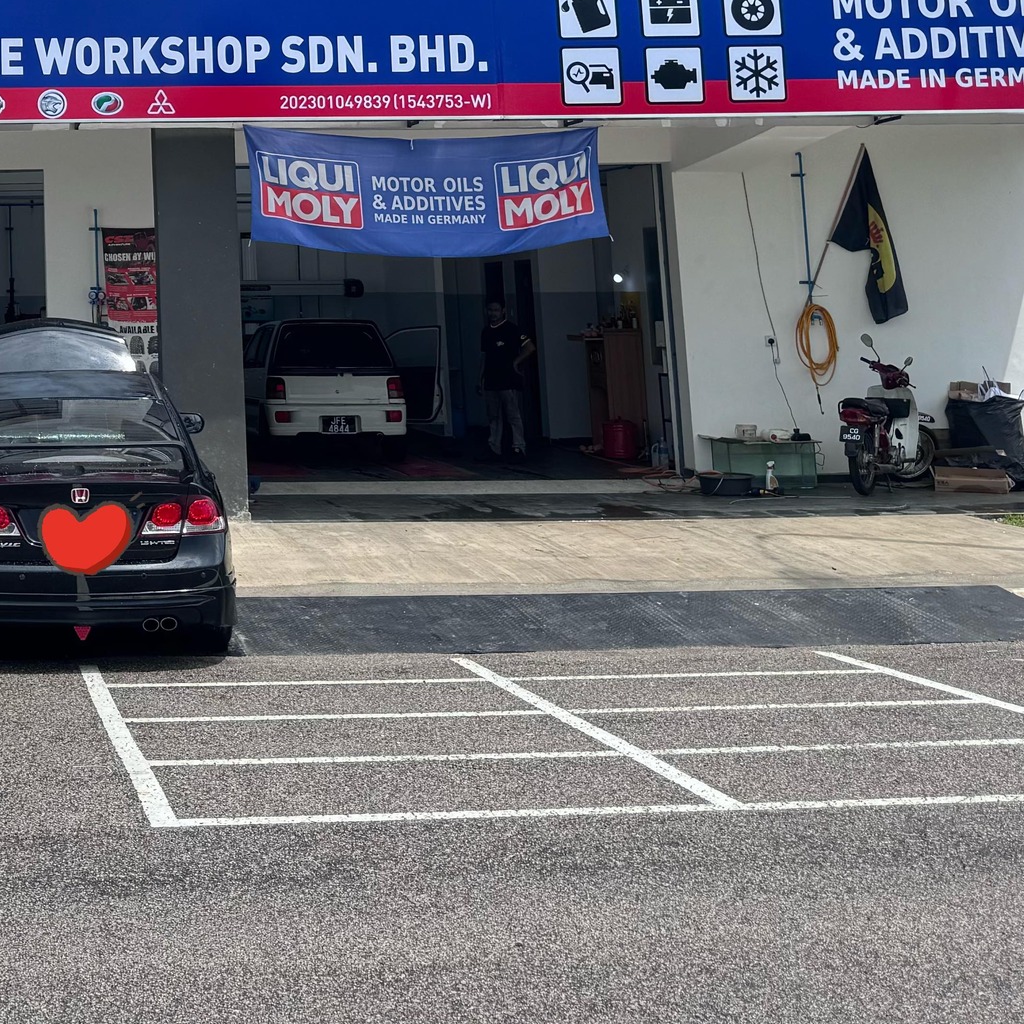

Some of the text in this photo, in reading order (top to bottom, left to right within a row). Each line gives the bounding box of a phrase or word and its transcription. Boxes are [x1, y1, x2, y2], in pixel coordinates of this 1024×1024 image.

[833, 25, 1024, 62] & ADDITIV
[34, 35, 271, 76] WORKSHOP
[280, 34, 377, 74] SDN.
[392, 34, 488, 73] BHD.
[837, 67, 1024, 90] MADE IN GERM
[262, 156, 355, 193] LIQUI
[500, 150, 588, 194] LIQUI
[371, 175, 484, 193] MOTOR OILS
[267, 188, 360, 225] MOLY
[372, 194, 486, 211] & ADDITIVES
[503, 182, 589, 226] MOLY
[374, 213, 486, 225] MADE IN GERMANY
[104, 252, 131, 262] CHOSEN
[132, 252, 142, 261] BY
[119, 325, 155, 334] AVAILABLE
[328, 424, 350, 433] 4844
[330, 416, 347, 425] JFE
[842, 433, 861, 441] 9540
